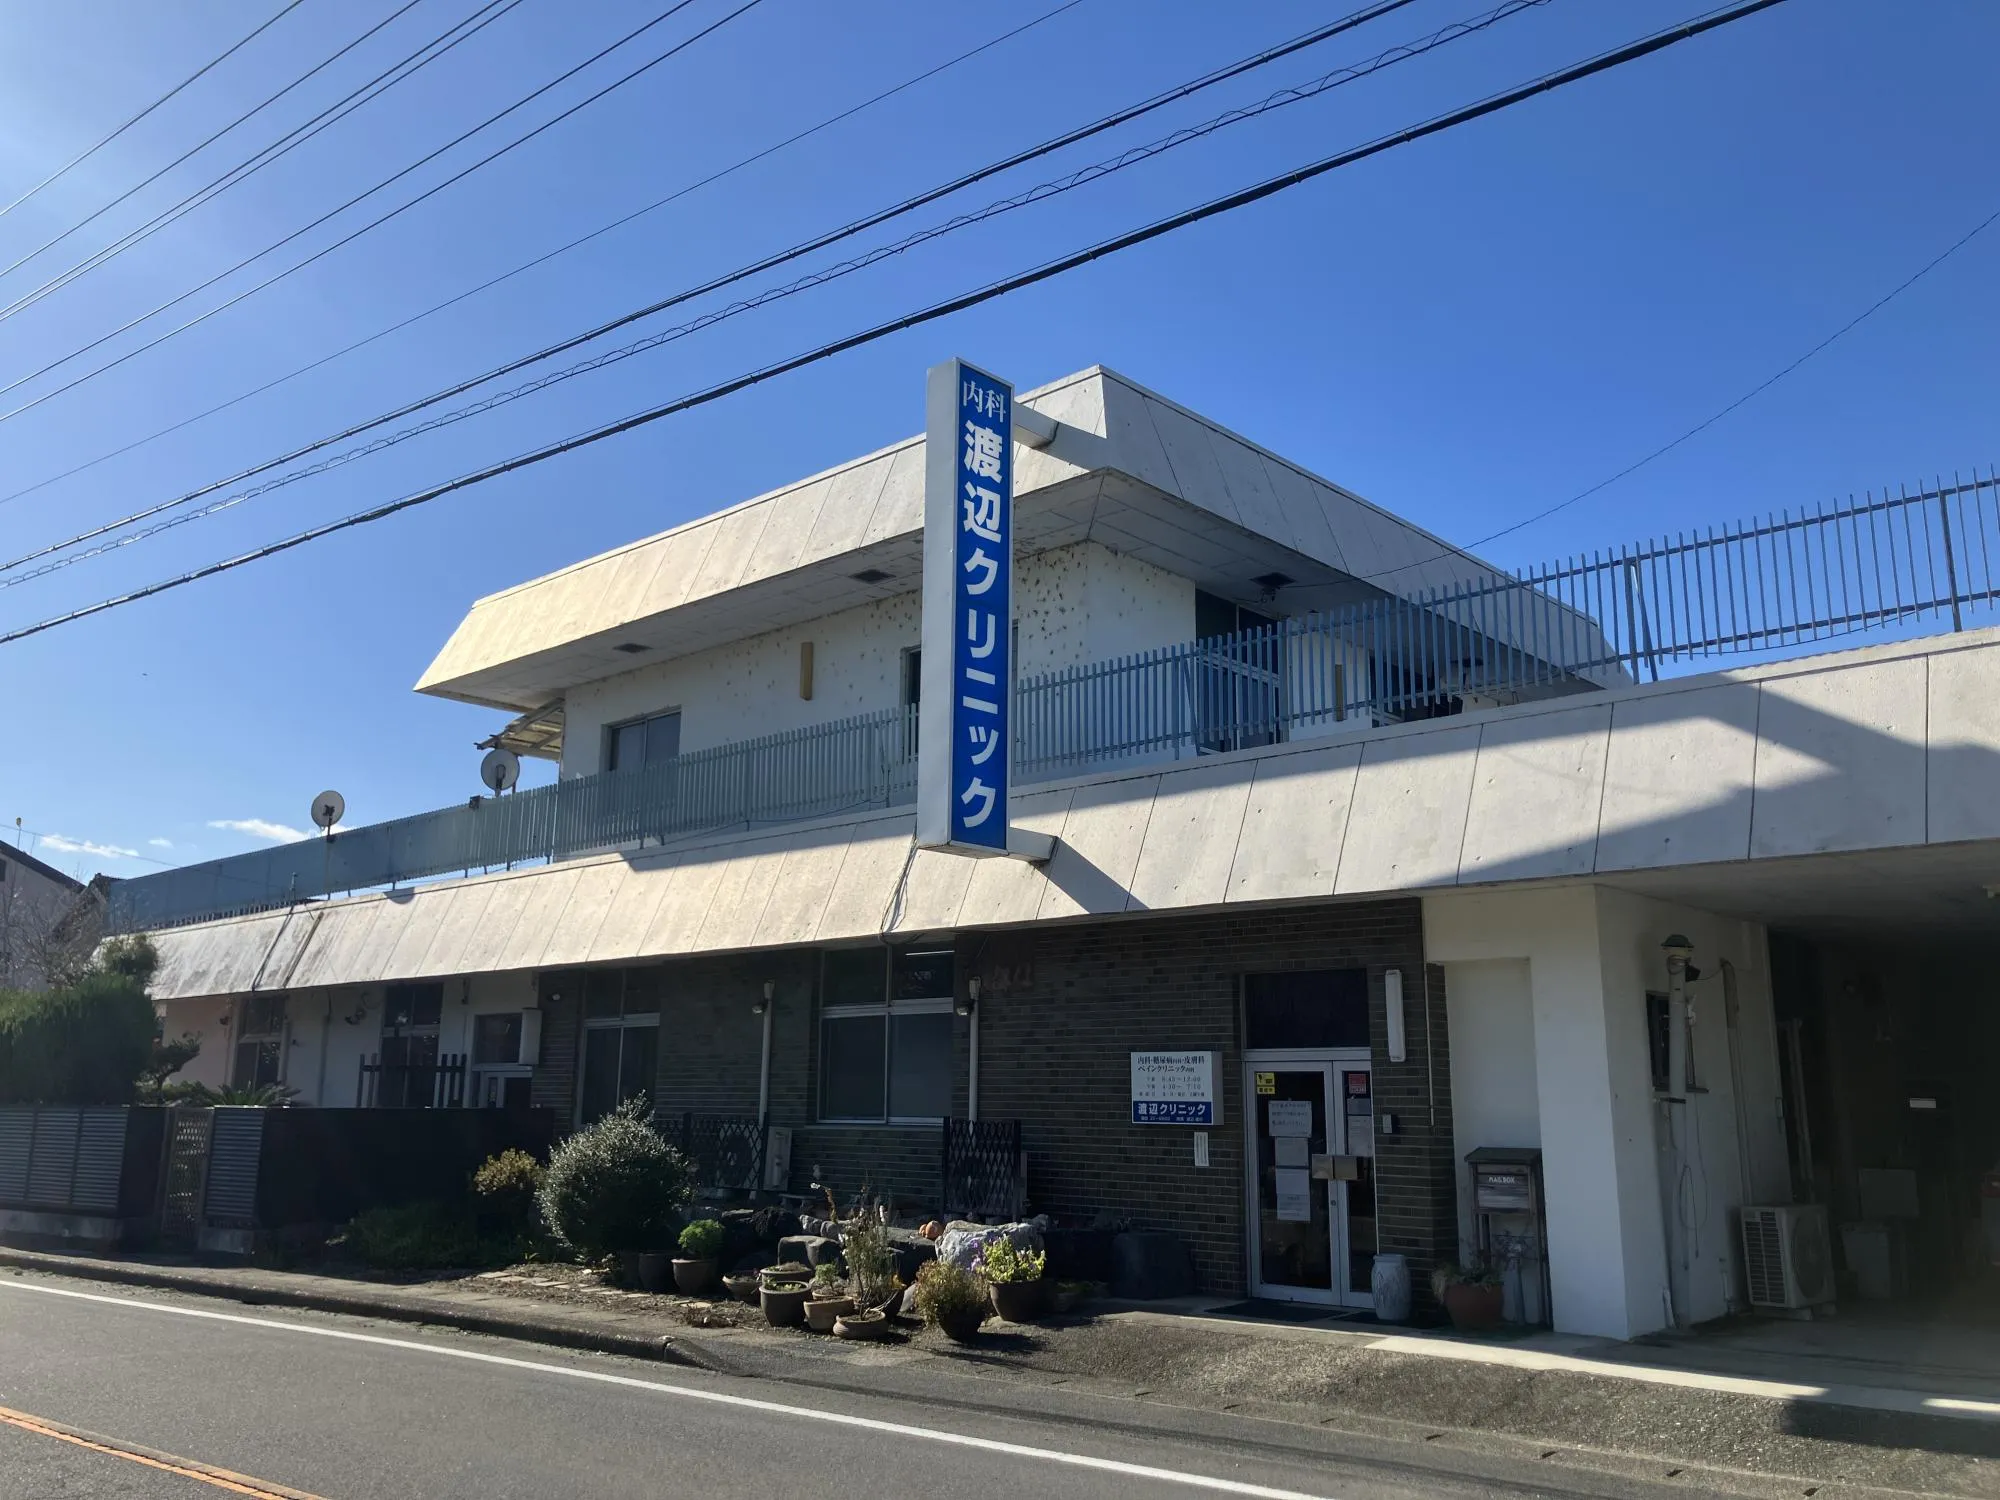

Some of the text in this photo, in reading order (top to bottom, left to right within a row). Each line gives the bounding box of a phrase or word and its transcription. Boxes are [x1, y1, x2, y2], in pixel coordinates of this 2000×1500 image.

[963, 380, 1006, 423] 内科
[961, 420, 1003, 828] 渡辺クリニック
[1138, 1103, 1206, 1115] 渡辺クリニック
